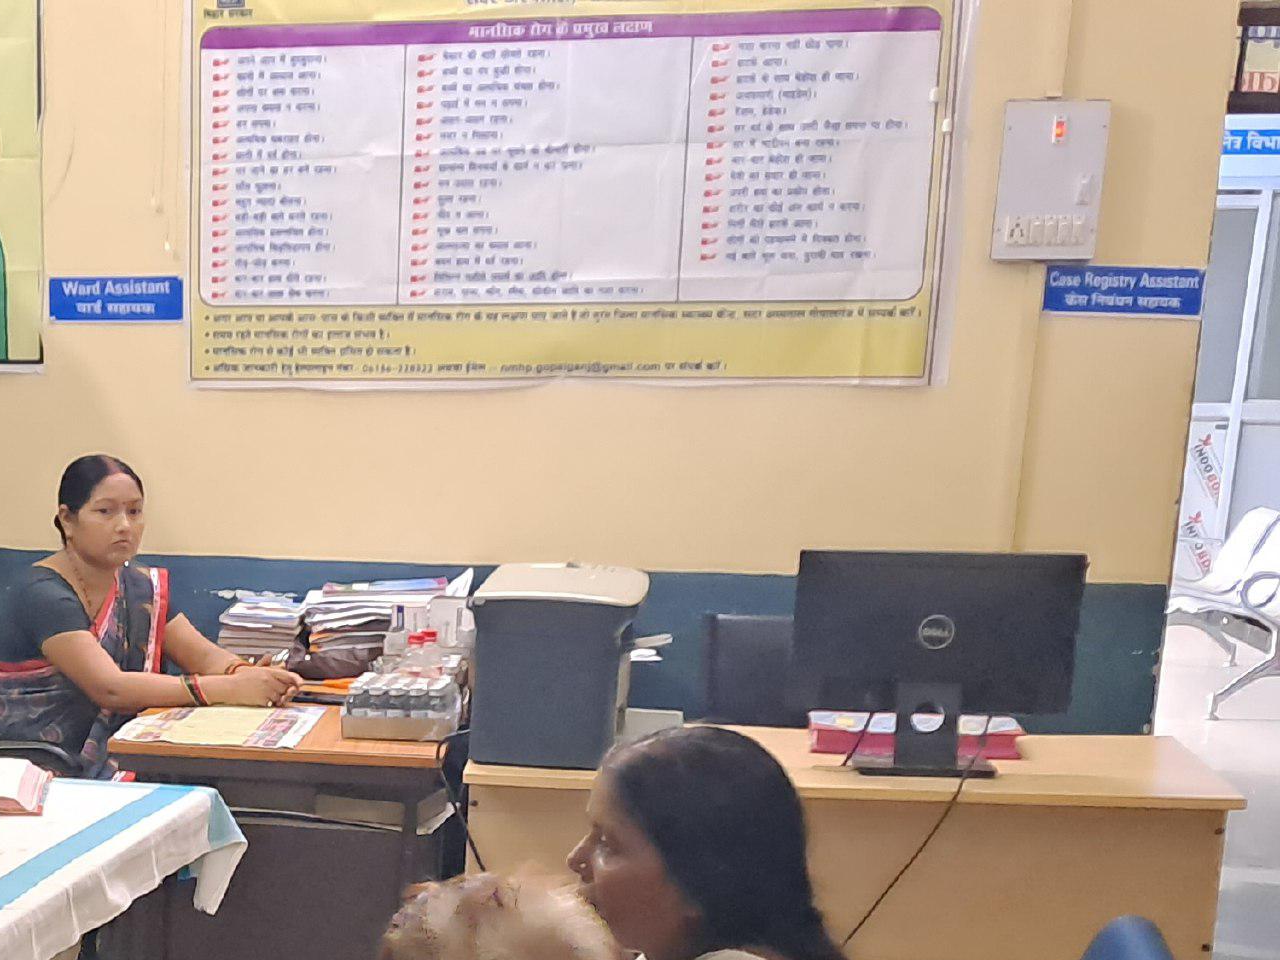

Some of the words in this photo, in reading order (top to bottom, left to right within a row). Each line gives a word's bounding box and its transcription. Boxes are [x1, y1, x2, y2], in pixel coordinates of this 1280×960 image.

[62, 281, 101, 296] Ward
[104, 279, 170, 295] Assistant
[1049, 270, 1081, 287] Case
[1085, 271, 1137, 291] Registry
[1139, 272, 1200, 289] Assistant
